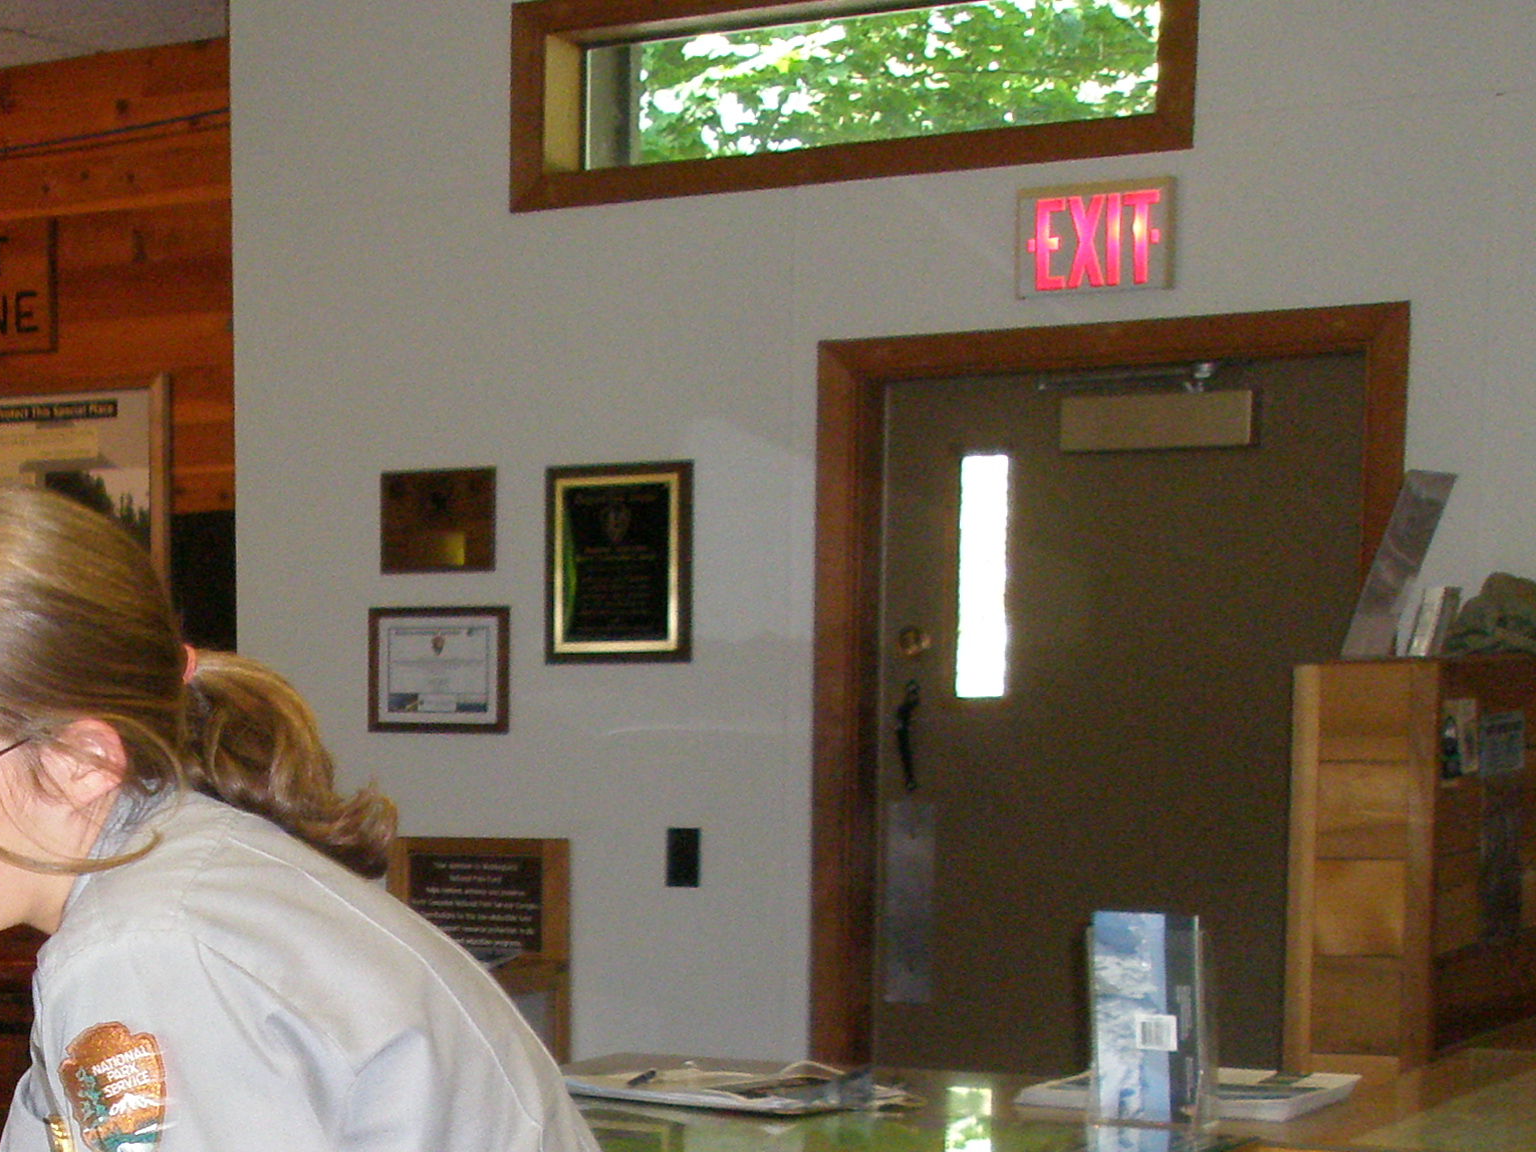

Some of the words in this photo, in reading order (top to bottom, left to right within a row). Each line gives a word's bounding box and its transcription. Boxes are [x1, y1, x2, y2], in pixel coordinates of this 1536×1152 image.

[1035, 189, 1161, 291] EXIT
[92, 1044, 152, 1076] NATIONAL
[106, 1063, 139, 1082] PARK
[103, 1070, 151, 1098] SERVICE
